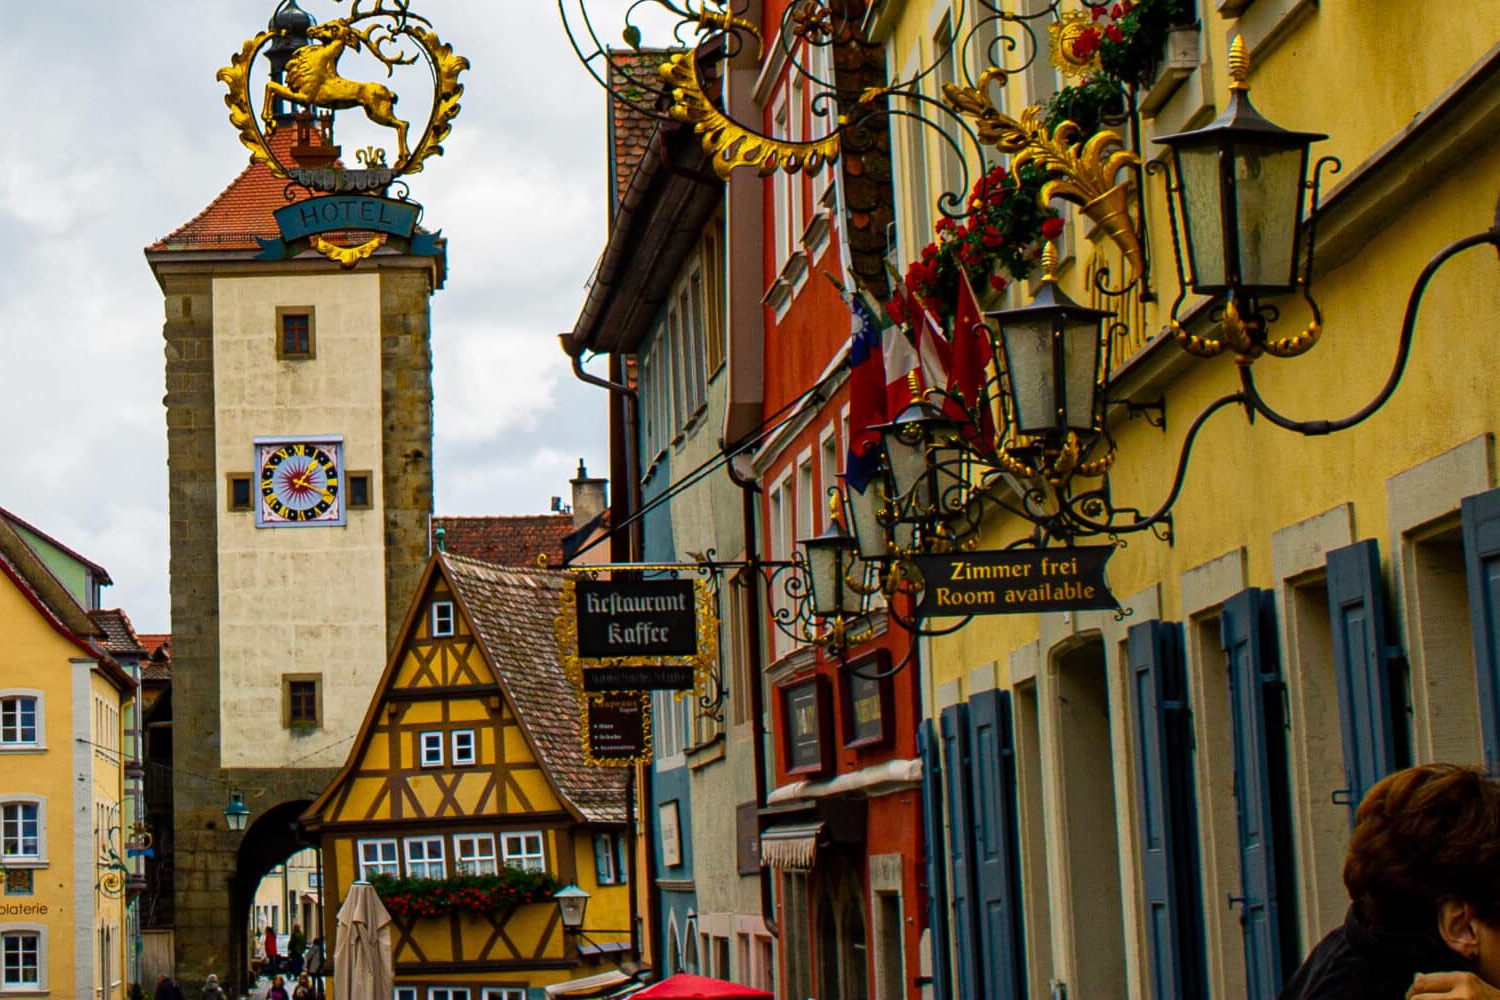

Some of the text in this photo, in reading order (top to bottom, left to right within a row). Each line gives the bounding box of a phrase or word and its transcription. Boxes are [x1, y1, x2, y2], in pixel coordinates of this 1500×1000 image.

[299, 200, 392, 228] HOTEL
[950, 556, 1078, 581] Zimmer frei
[586, 592, 686, 615] Restaurant
[936, 582, 1095, 607] Room available
[607, 620, 670, 646] Kaffee
